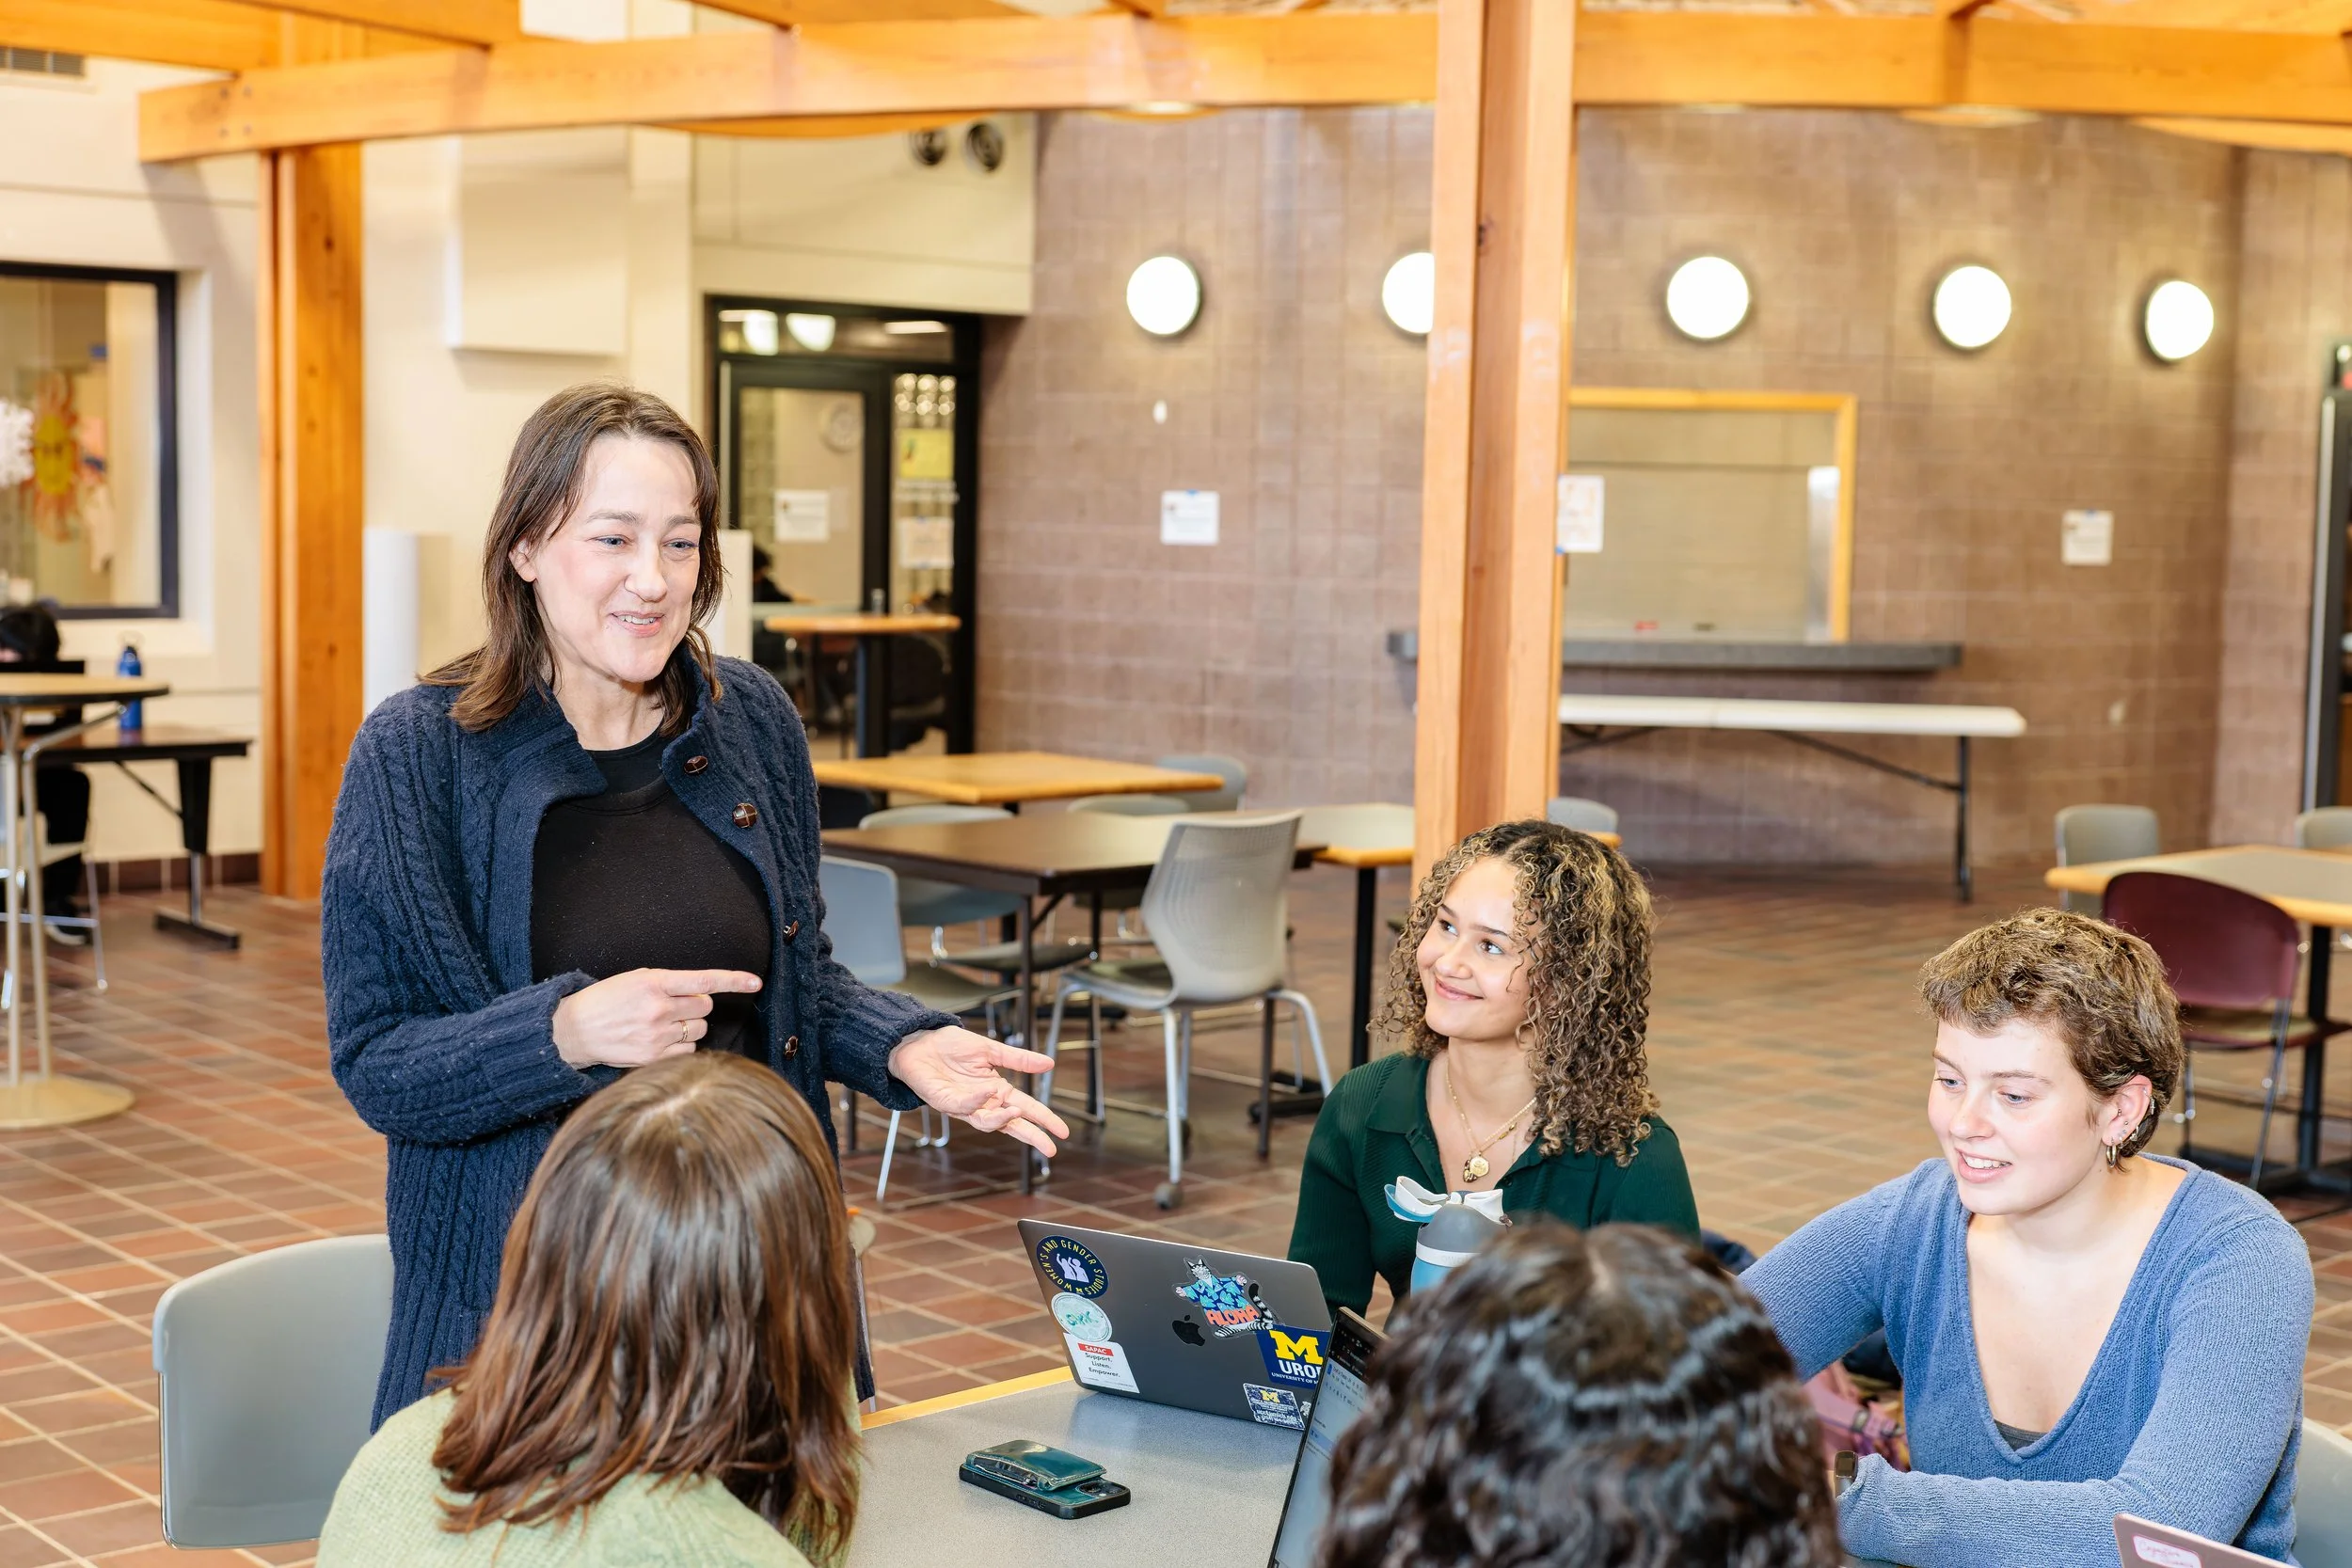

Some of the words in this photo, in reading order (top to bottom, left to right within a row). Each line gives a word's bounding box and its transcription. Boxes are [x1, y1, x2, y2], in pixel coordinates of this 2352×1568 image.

[1041, 1239, 1058, 1254] AND
[1060, 1239, 1097, 1265] GENDER
[1084, 1268, 1104, 1295] STUDIES
[1205, 1305, 1260, 1326] ALOHA
[1084, 1345, 1107, 1354] SAPAC
[1268, 1329, 1324, 1366] M
[1271, 1372, 1305, 1383] UNIVERSITY
